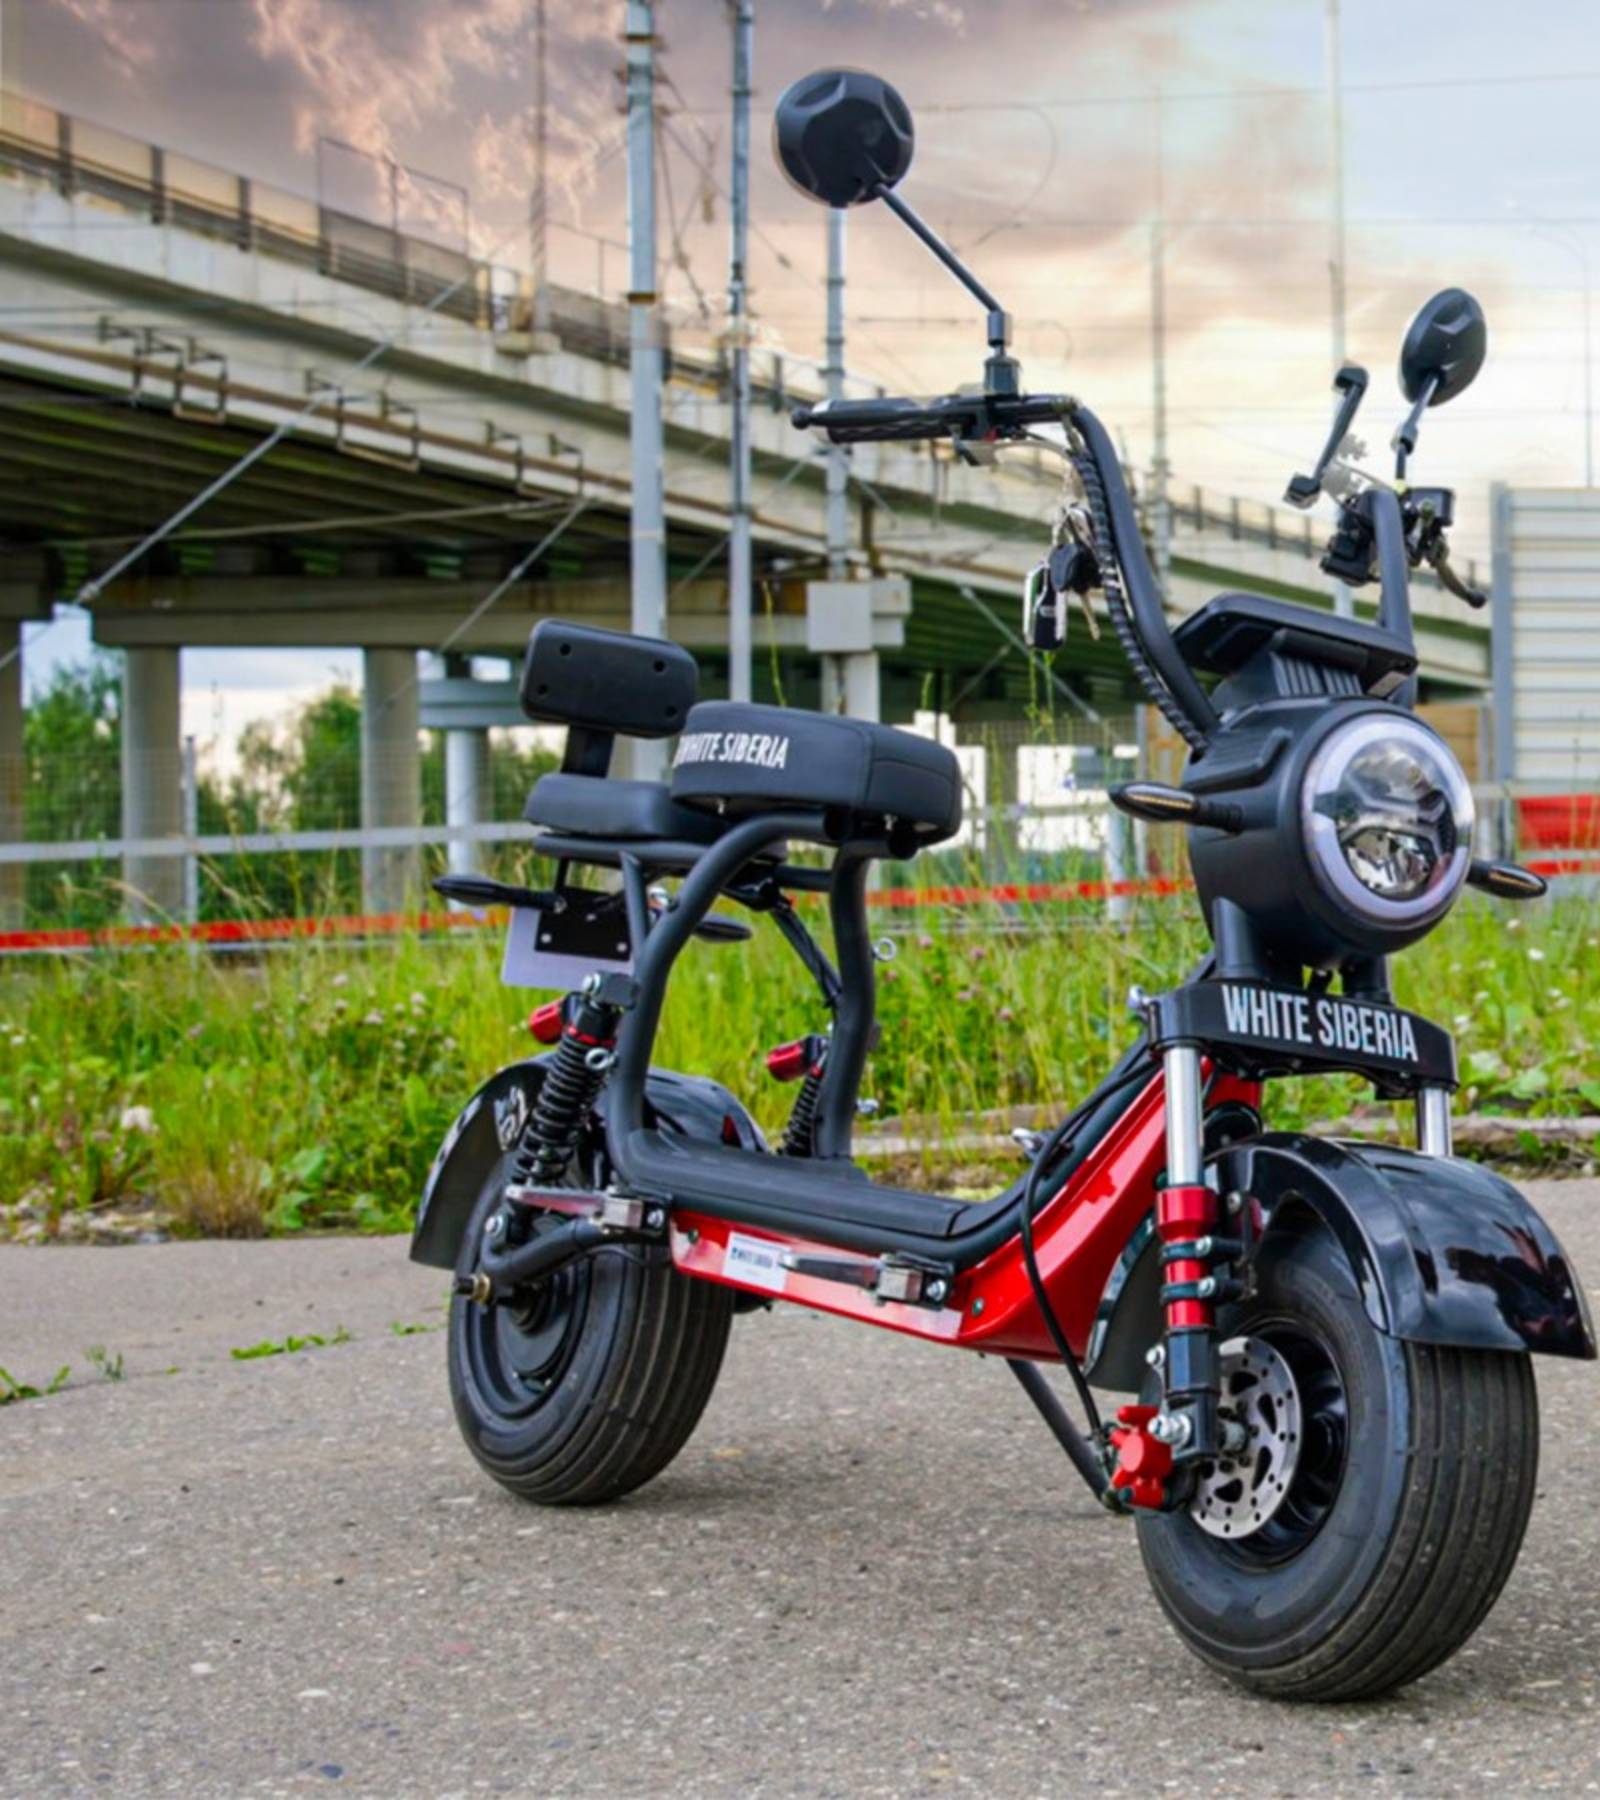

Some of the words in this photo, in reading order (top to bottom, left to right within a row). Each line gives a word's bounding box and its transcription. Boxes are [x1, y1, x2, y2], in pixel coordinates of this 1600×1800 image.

[672, 732, 722, 768] WHITE
[719, 731, 789, 769] SIBERIA
[1222, 984, 1313, 1043] WHITE
[1316, 999, 1418, 1062] SIBERIA
